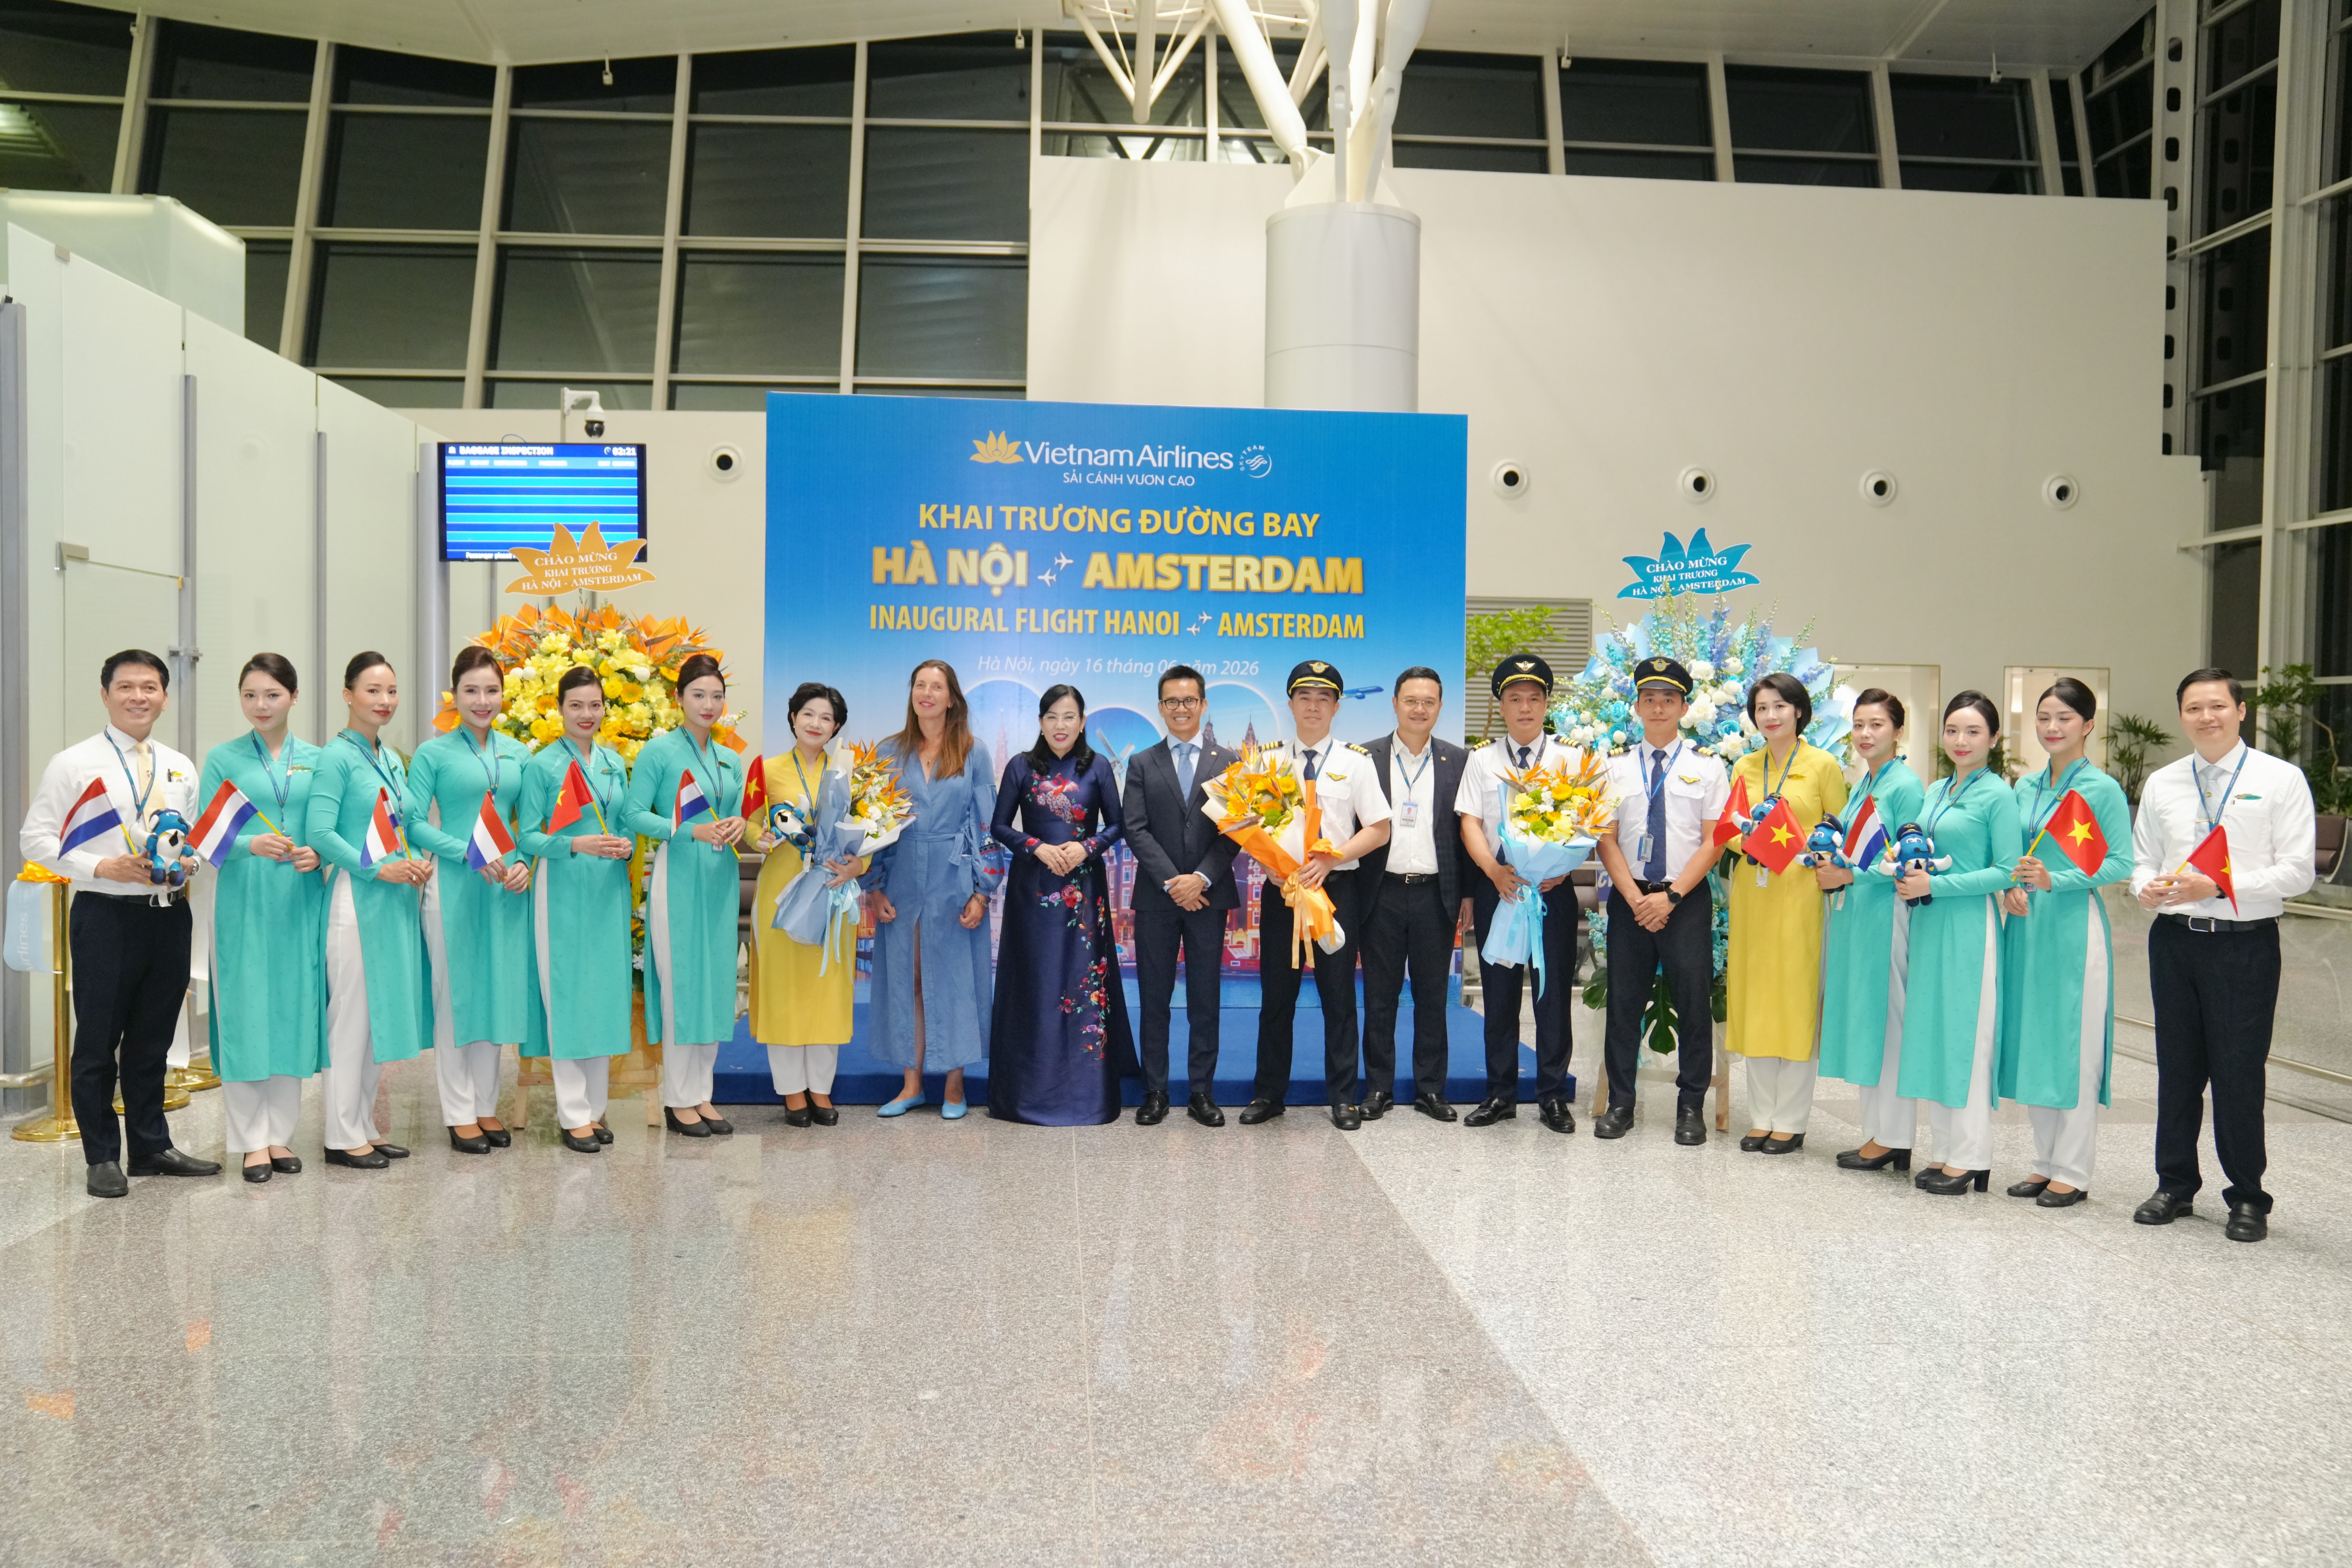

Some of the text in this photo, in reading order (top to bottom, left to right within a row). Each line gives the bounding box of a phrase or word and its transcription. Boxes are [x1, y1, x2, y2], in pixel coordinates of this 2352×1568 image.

[459, 446, 554, 456] BAGGAGE INSPECTION
[612, 447, 636, 456] 02:21
[1025, 441, 1233, 469] Vietnam Airlines
[1239, 445, 1265, 471] SKYTEAM
[1063, 469, 1195, 486] SẢI CÁNH VƯƠN CAO
[920, 504, 1320, 537] KHAI TRƯƠNG ĐƯỜNG BAY
[535, 552, 618, 566] CHÀO MỪNG
[1646, 556, 1727, 573] CHÀO MỪNG
[545, 565, 612, 577] KHAI TRƯƠNG
[872, 540, 1363, 597] HÀ NỘI AMSTERDAM
[1653, 569, 1718, 583] KHAI TRƯƠNG
[522, 580, 538, 590] HÀ
[542, 578, 561, 590] NỘI
[571, 573, 642, 587] AMSTERDAM
[1633, 586, 1647, 596] HÀ
[1651, 584, 1666, 594] NỘ
[1678, 577, 1746, 591] AMSTERDAM
[870, 605, 1364, 638] INAUGURAL FLIGHT HANOI AMSTERDAM
[978, 656, 1000, 671] Hà
[1004, 656, 1035, 675] Nội,
[1040, 657, 1080, 676] ngày
[1086, 658, 1103, 672] 16
[1107, 657, 1153, 678] tháng
[1220, 660, 1259, 675] 2026
